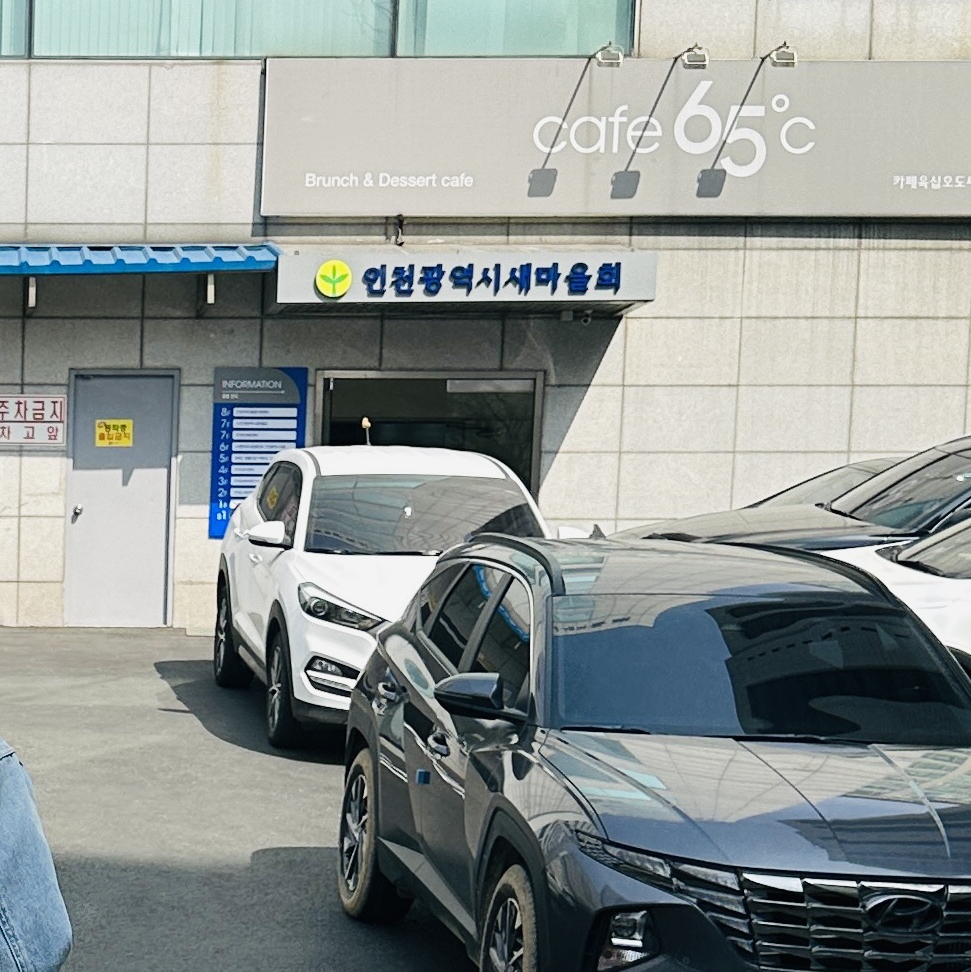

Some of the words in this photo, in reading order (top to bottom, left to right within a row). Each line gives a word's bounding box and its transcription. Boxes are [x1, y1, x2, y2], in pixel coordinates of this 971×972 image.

[532, 104, 663, 154] cafe
[304, 172, 359, 188] Brunch
[362, 172, 375, 188] &
[378, 172, 437, 188] Dessert
[440, 172, 475, 188] cafe
[892, 174, 971, 190] 카페육십오도
[221, 379, 283, 389] INFORMATION
